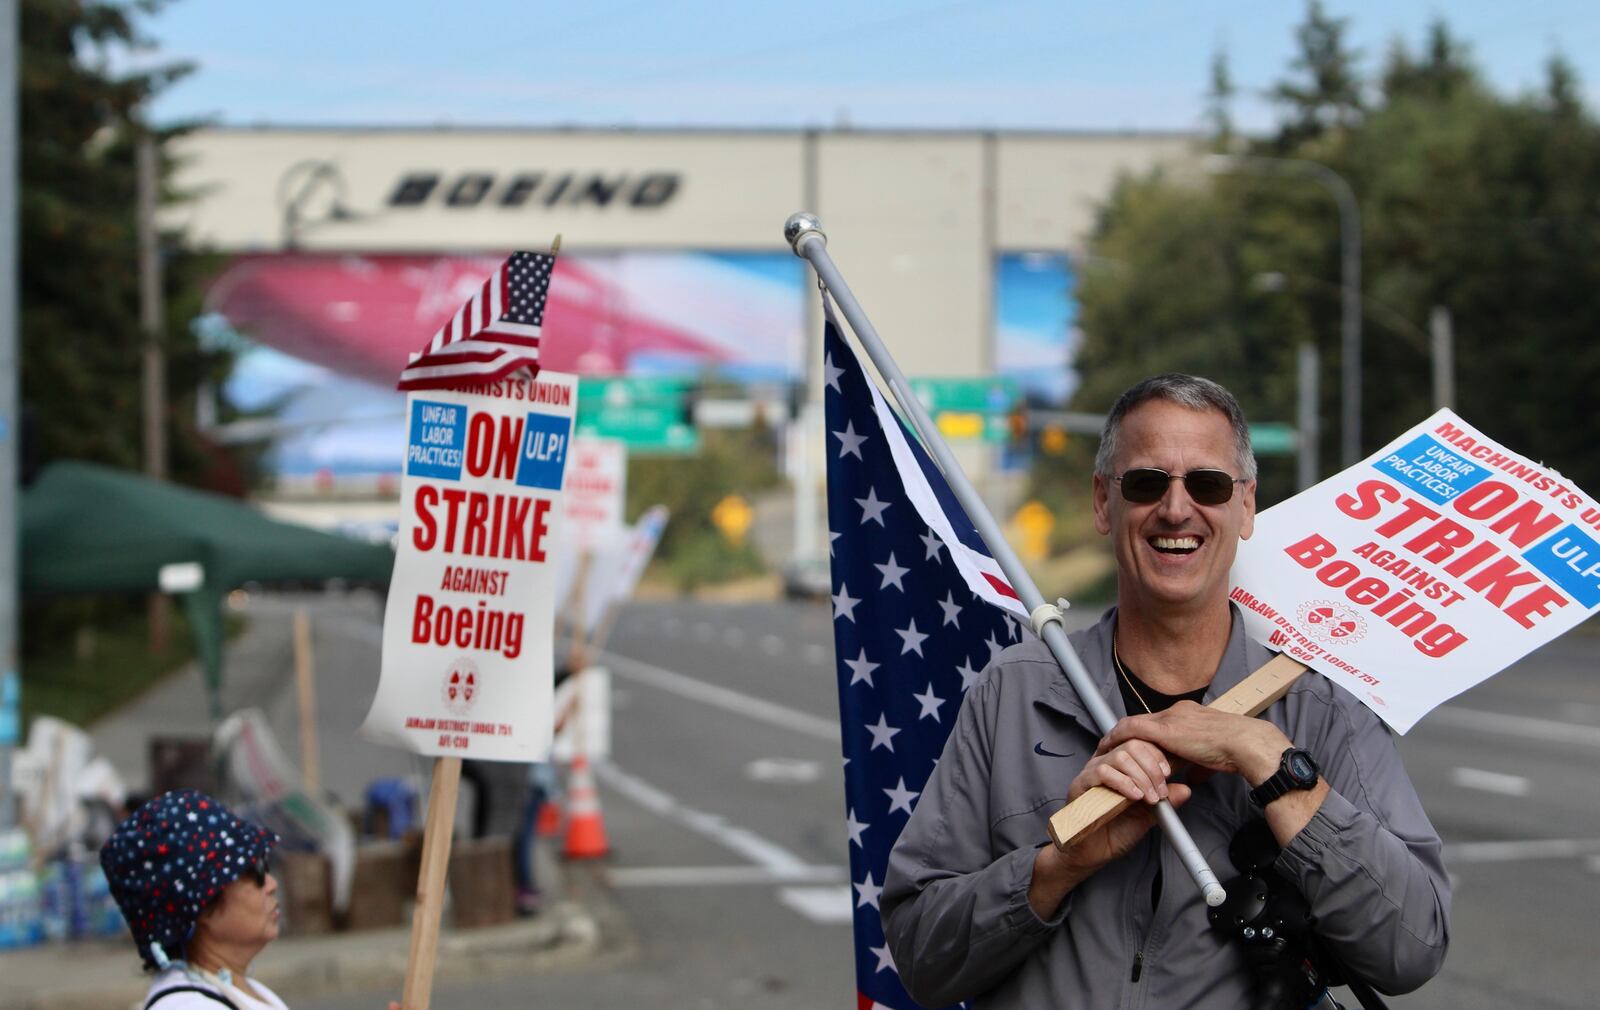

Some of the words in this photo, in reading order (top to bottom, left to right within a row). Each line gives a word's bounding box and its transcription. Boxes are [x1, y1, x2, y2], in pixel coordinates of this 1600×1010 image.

[385, 170, 682, 208] BOEING
[422, 405, 457, 426] UNFAIR
[528, 380, 571, 406] UNION
[408, 444, 462, 467] PRACTICES!
[421, 425, 454, 446] LABOR
[466, 411, 524, 480] ON
[525, 431, 564, 463] ULP!
[1383, 454, 1460, 499] PRACTICES!
[1412, 454, 1459, 483] LABOR
[1425, 445, 1475, 476] UNFAIR
[1434, 422, 1583, 509] MACHINISTS
[412, 484, 552, 563] STRIKE
[1453, 480, 1564, 549] ON
[1335, 479, 1569, 630] STRIKE
[1352, 541, 1465, 608] AGAINST
[441, 565, 509, 597] AGAINST
[1283, 533, 1469, 658] Boeing
[411, 594, 524, 660] Boeing
[1229, 586, 1278, 620] IAM&AW
[1275, 616, 1327, 655] DISTRICT
[1323, 654, 1360, 675] LODGE
[1358, 673, 1381, 686] 751
